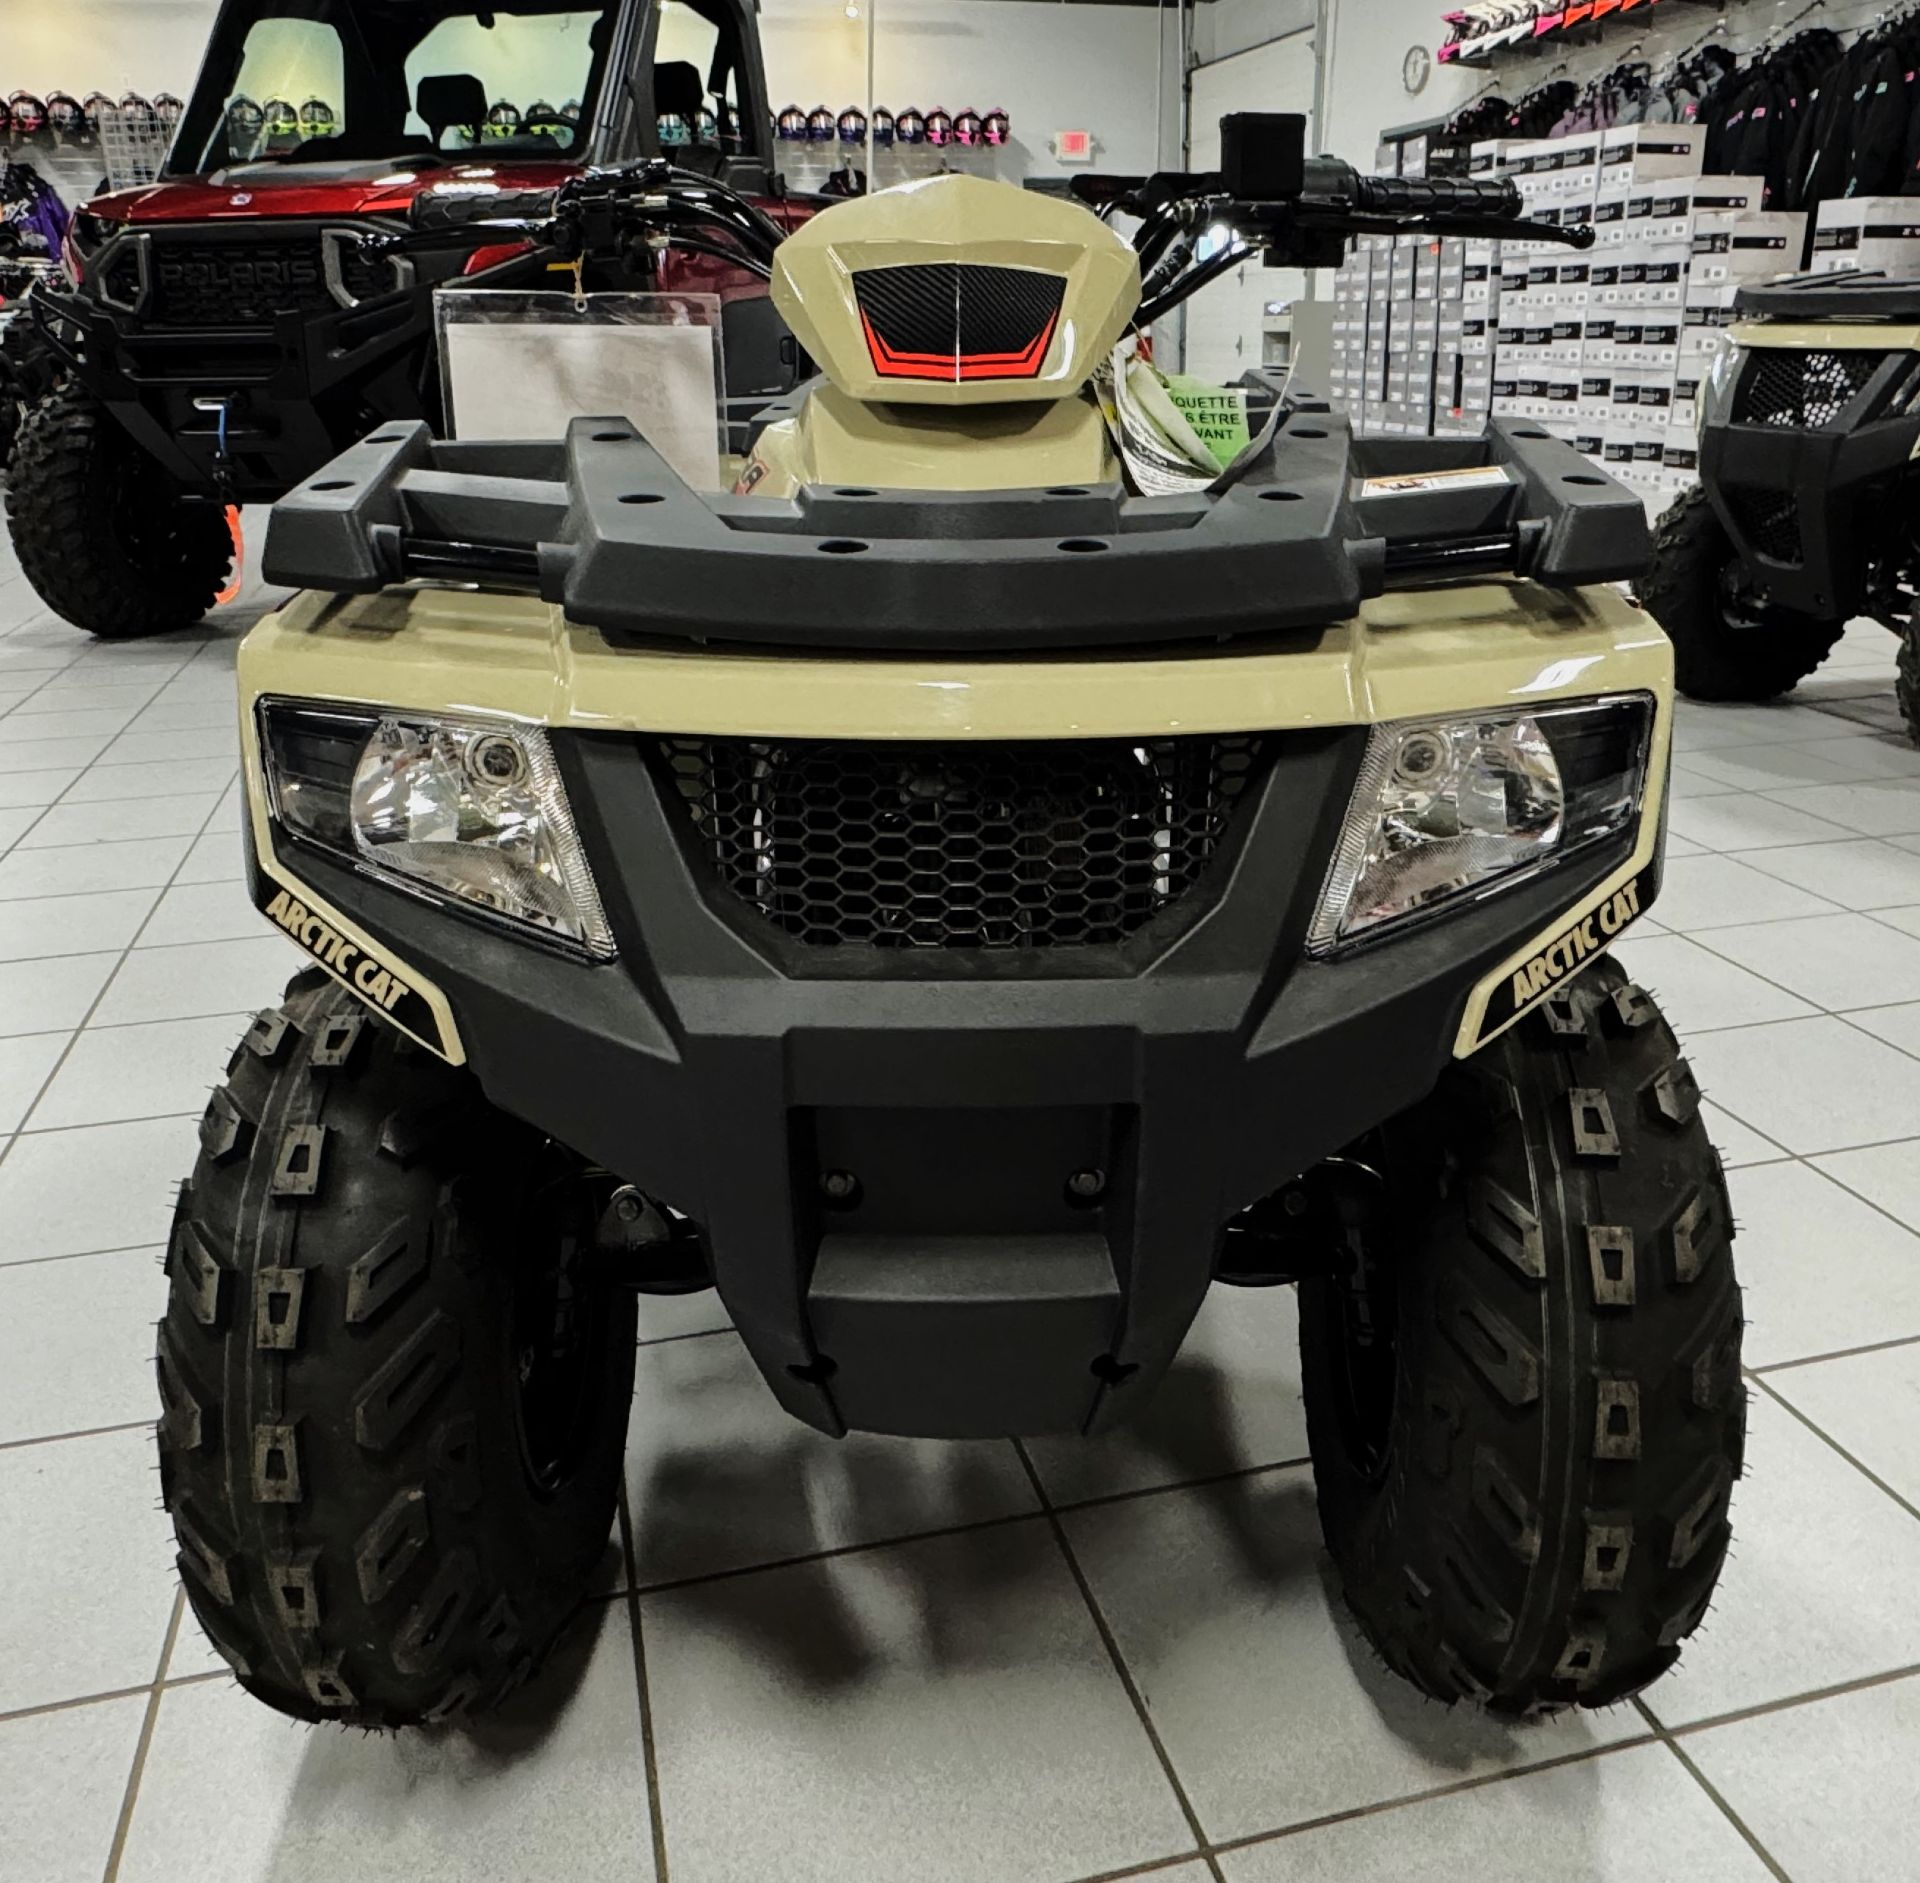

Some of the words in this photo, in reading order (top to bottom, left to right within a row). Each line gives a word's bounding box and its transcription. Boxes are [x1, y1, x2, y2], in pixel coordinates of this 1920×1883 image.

[159, 261, 318, 286] POLARIS
[1199, 409, 1241, 425] ÊTRE
[265, 889, 359, 975] ARCTIC
[354, 959, 410, 1012] CAT
[1512, 915, 1599, 1009] ARCTIC
[1600, 878, 1640, 936] CAT
